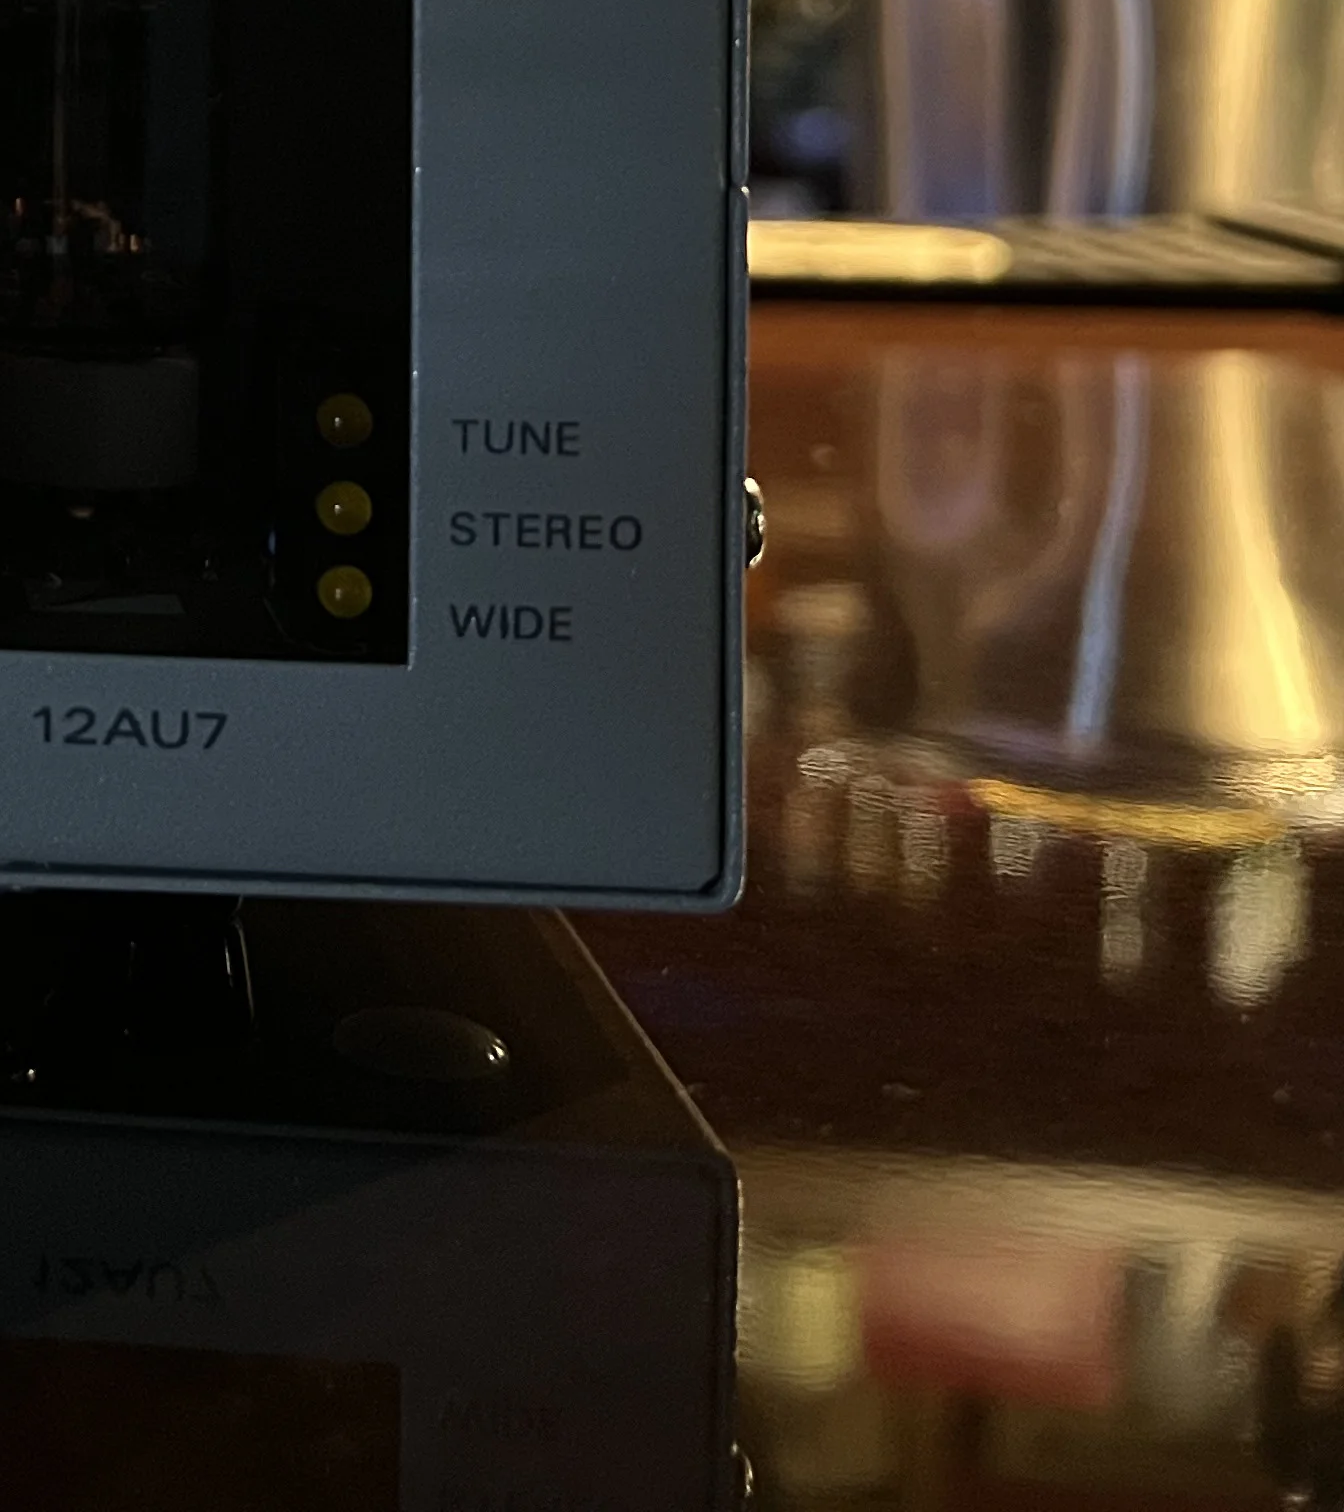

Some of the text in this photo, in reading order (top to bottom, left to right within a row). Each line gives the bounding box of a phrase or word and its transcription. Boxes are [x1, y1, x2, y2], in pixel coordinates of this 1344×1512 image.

[452, 419, 580, 457] TUNE
[450, 511, 642, 551] STEREO
[450, 604, 573, 641] WIDE
[33, 706, 229, 750] 12AU7
